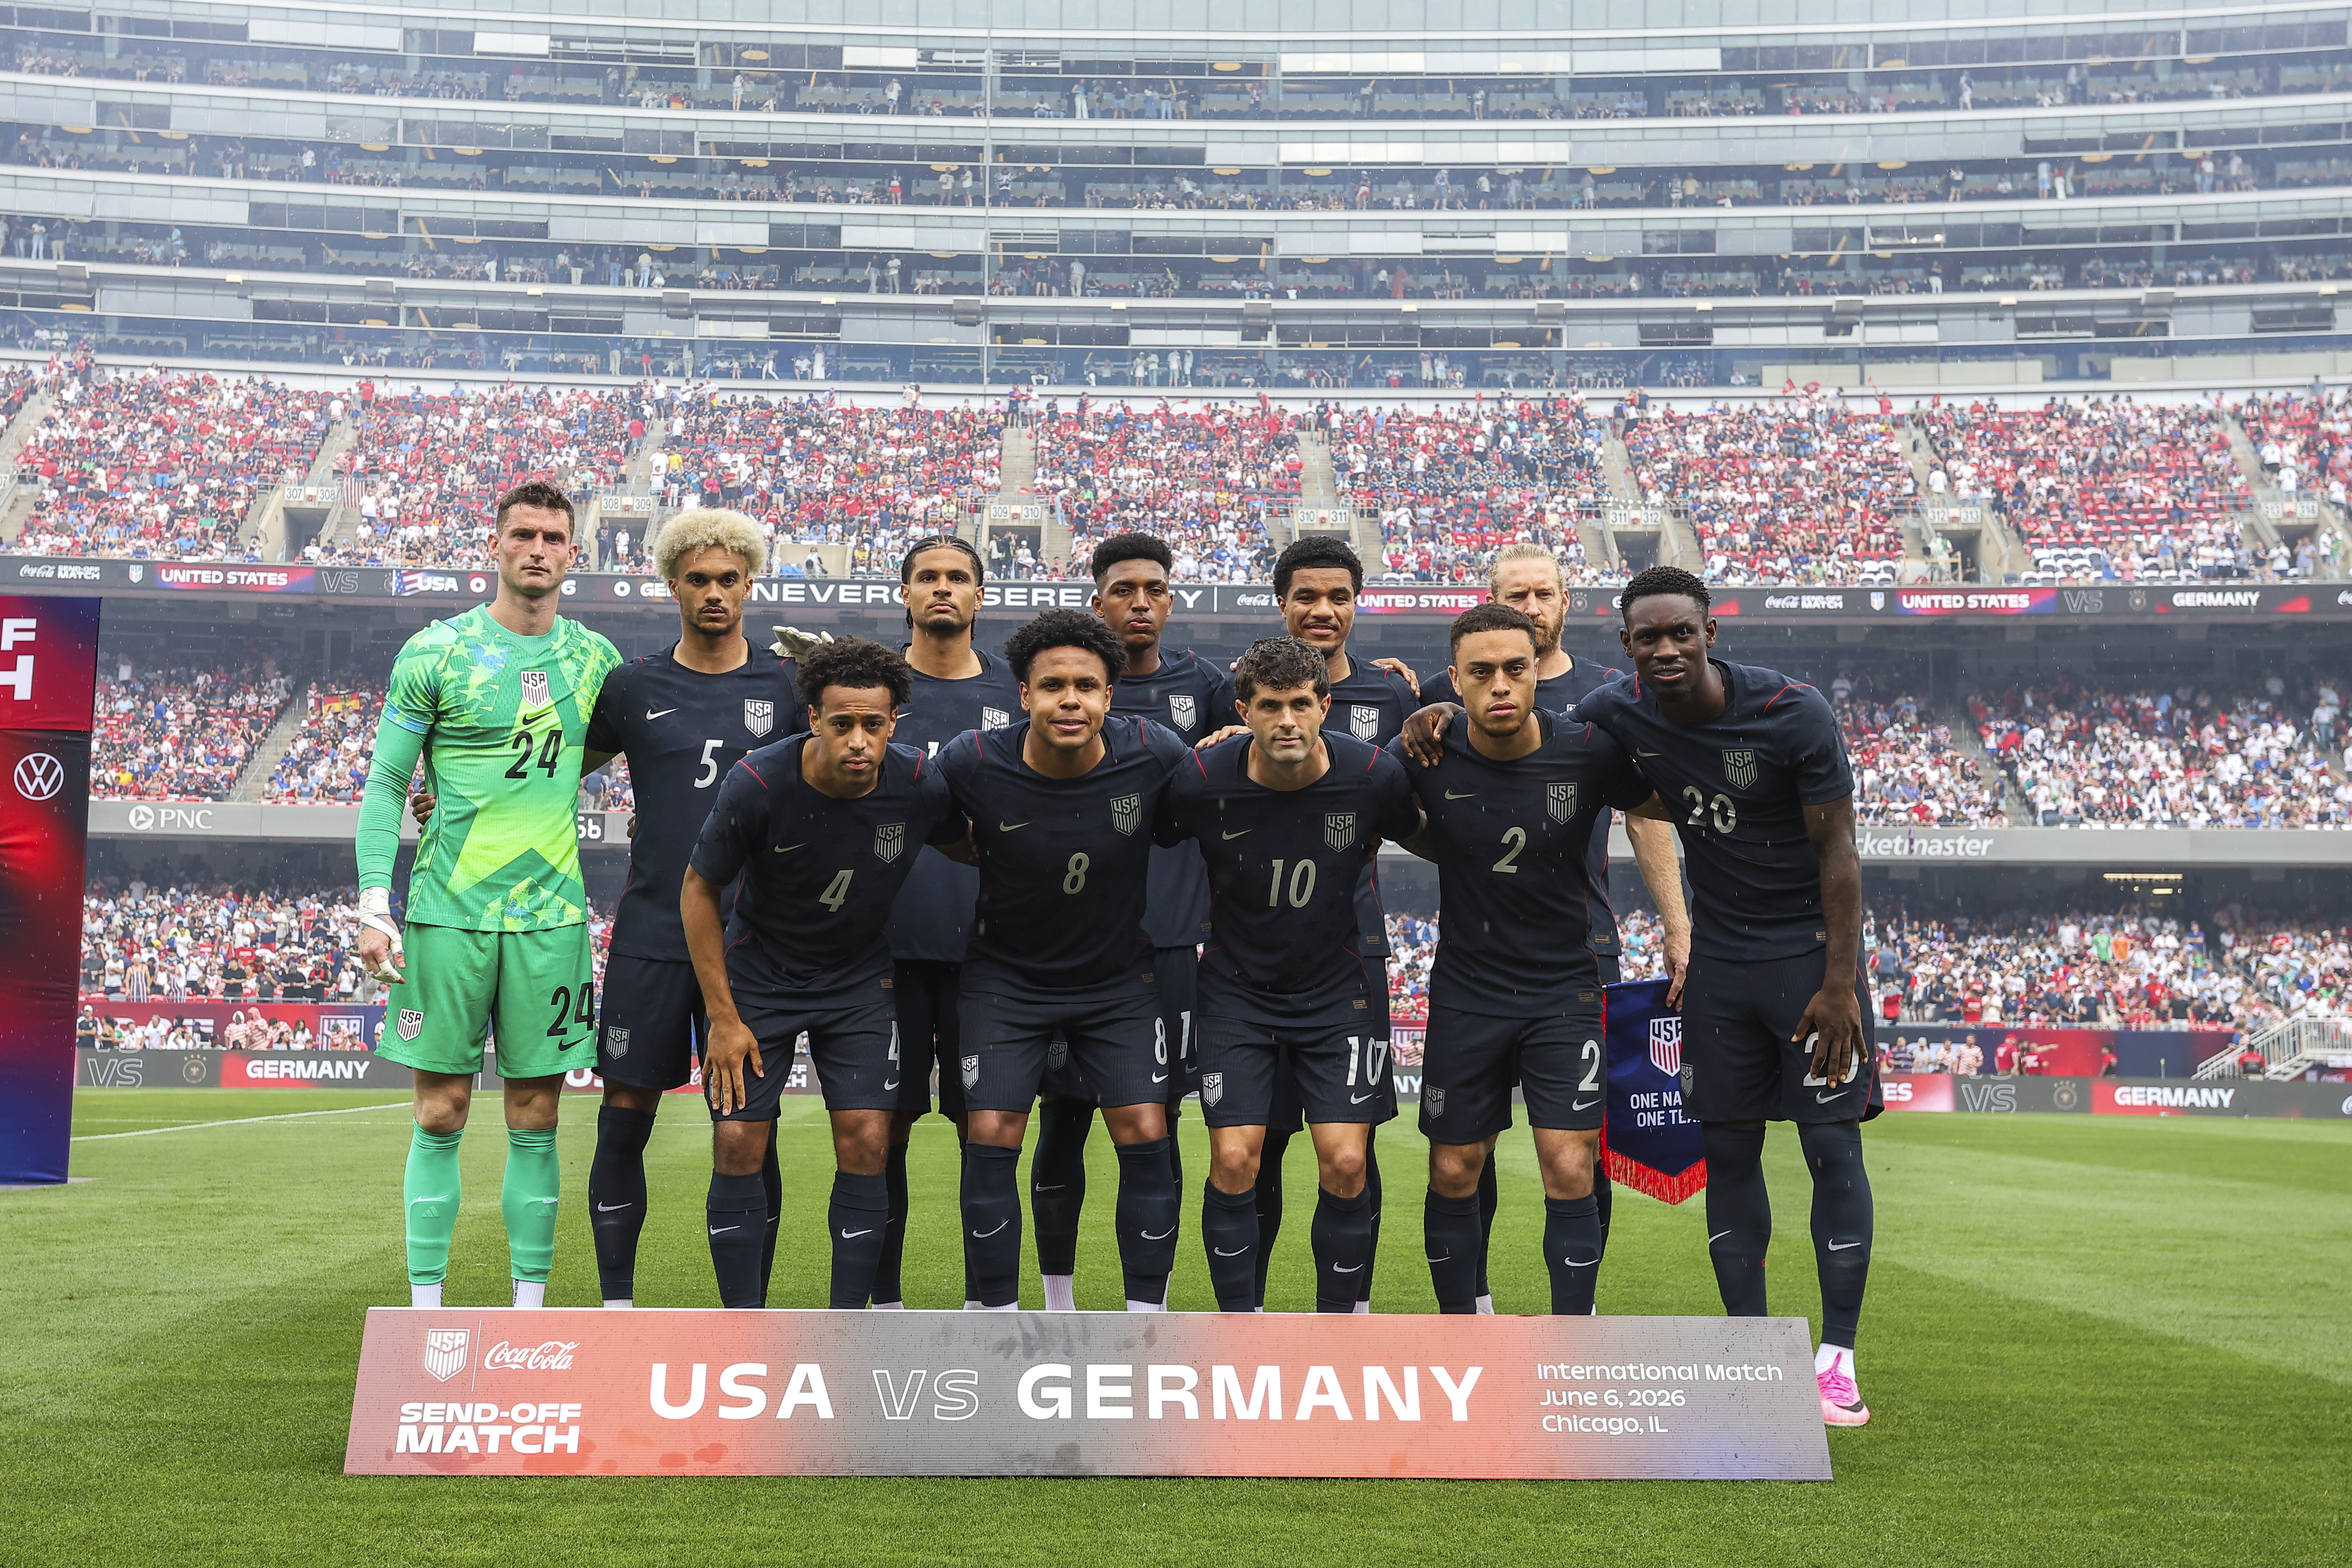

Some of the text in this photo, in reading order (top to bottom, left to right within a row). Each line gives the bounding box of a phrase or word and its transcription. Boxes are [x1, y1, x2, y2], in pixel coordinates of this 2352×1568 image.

[286, 488, 302, 499] 307
[320, 489, 335, 500] 308
[604, 498, 619, 509] 308
[636, 499, 651, 509] 309
[993, 507, 1008, 517] 309
[1024, 507, 1039, 518] 310
[1300, 511, 1315, 521] 310
[1332, 511, 1346, 522] 311
[1612, 512, 1626, 523] 311
[1644, 512, 1658, 523] 312
[1930, 510, 1945, 521] 312
[1963, 510, 1979, 522] 313
[20, 564, 56, 578] Coca-Cola
[57, 571, 100, 580] MATCH
[161, 569, 288, 586] UNITED STATES
[322, 570, 358, 593] VS
[418, 576, 459, 592] USA
[1237, 594, 1271, 606] Coca-Cola
[1357, 595, 1478, 608] UNITED STATES
[1765, 595, 1800, 609] Coca-Cola
[1801, 600, 1843, 609] MATCH
[1902, 594, 2030, 609] UNITED STATES
[2064, 590, 2103, 613] VS
[2172, 591, 2259, 607] GERMANY
[524, 673, 545, 687] USA
[747, 701, 771, 717] USA
[1172, 698, 1193, 711] USA
[985, 709, 1007, 725] USA
[1354, 708, 1376, 722] USA
[505, 730, 562, 779] 24
[1726, 752, 1752, 767] USA
[694, 740, 723, 788] 5
[1550, 786, 1574, 801] USA
[1114, 796, 1138, 814] USA
[1683, 785, 1738, 834] 20
[159, 808, 213, 830] PNC
[1328, 816, 1353, 830] USA
[878, 826, 903, 841] USA
[1492, 827, 1527, 873] 2
[1856, 831, 1994, 857] ketmaster
[1063, 852, 1090, 895] 8
[819, 869, 855, 912] 4
[1270, 859, 1317, 908] 10
[547, 981, 595, 1037] 24
[402, 1011, 422, 1024] USA
[611, 1028, 628, 1042] USA
[1155, 1017, 1168, 1065] 8
[246, 1059, 370, 1079] GERMANY
[964, 1058, 977, 1071] USA
[1578, 1039, 1600, 1091] 2
[88, 1058, 143, 1088] VS
[1205, 1075, 1220, 1088] USA
[1427, 1088, 1443, 1101] USA
[1630, 1092, 1659, 1109] ONE
[1962, 1083, 2017, 1113] VS
[2114, 1086, 2235, 1108] GERMANY
[1637, 1109, 1700, 1127] ONE TE
[431, 1332, 467, 1352] USA
[484, 1340, 580, 1370] Coca-Cola
[1537, 1362, 1783, 1382] International Match
[649, 1362, 1484, 1422] USA VS GERMANY
[1540, 1389, 1686, 1409] June 6, 2026
[398, 1402, 582, 1424] SEND-OFF
[1542, 1414, 1669, 1436] Chicago, IL
[395, 1425, 580, 1454] MATCH
